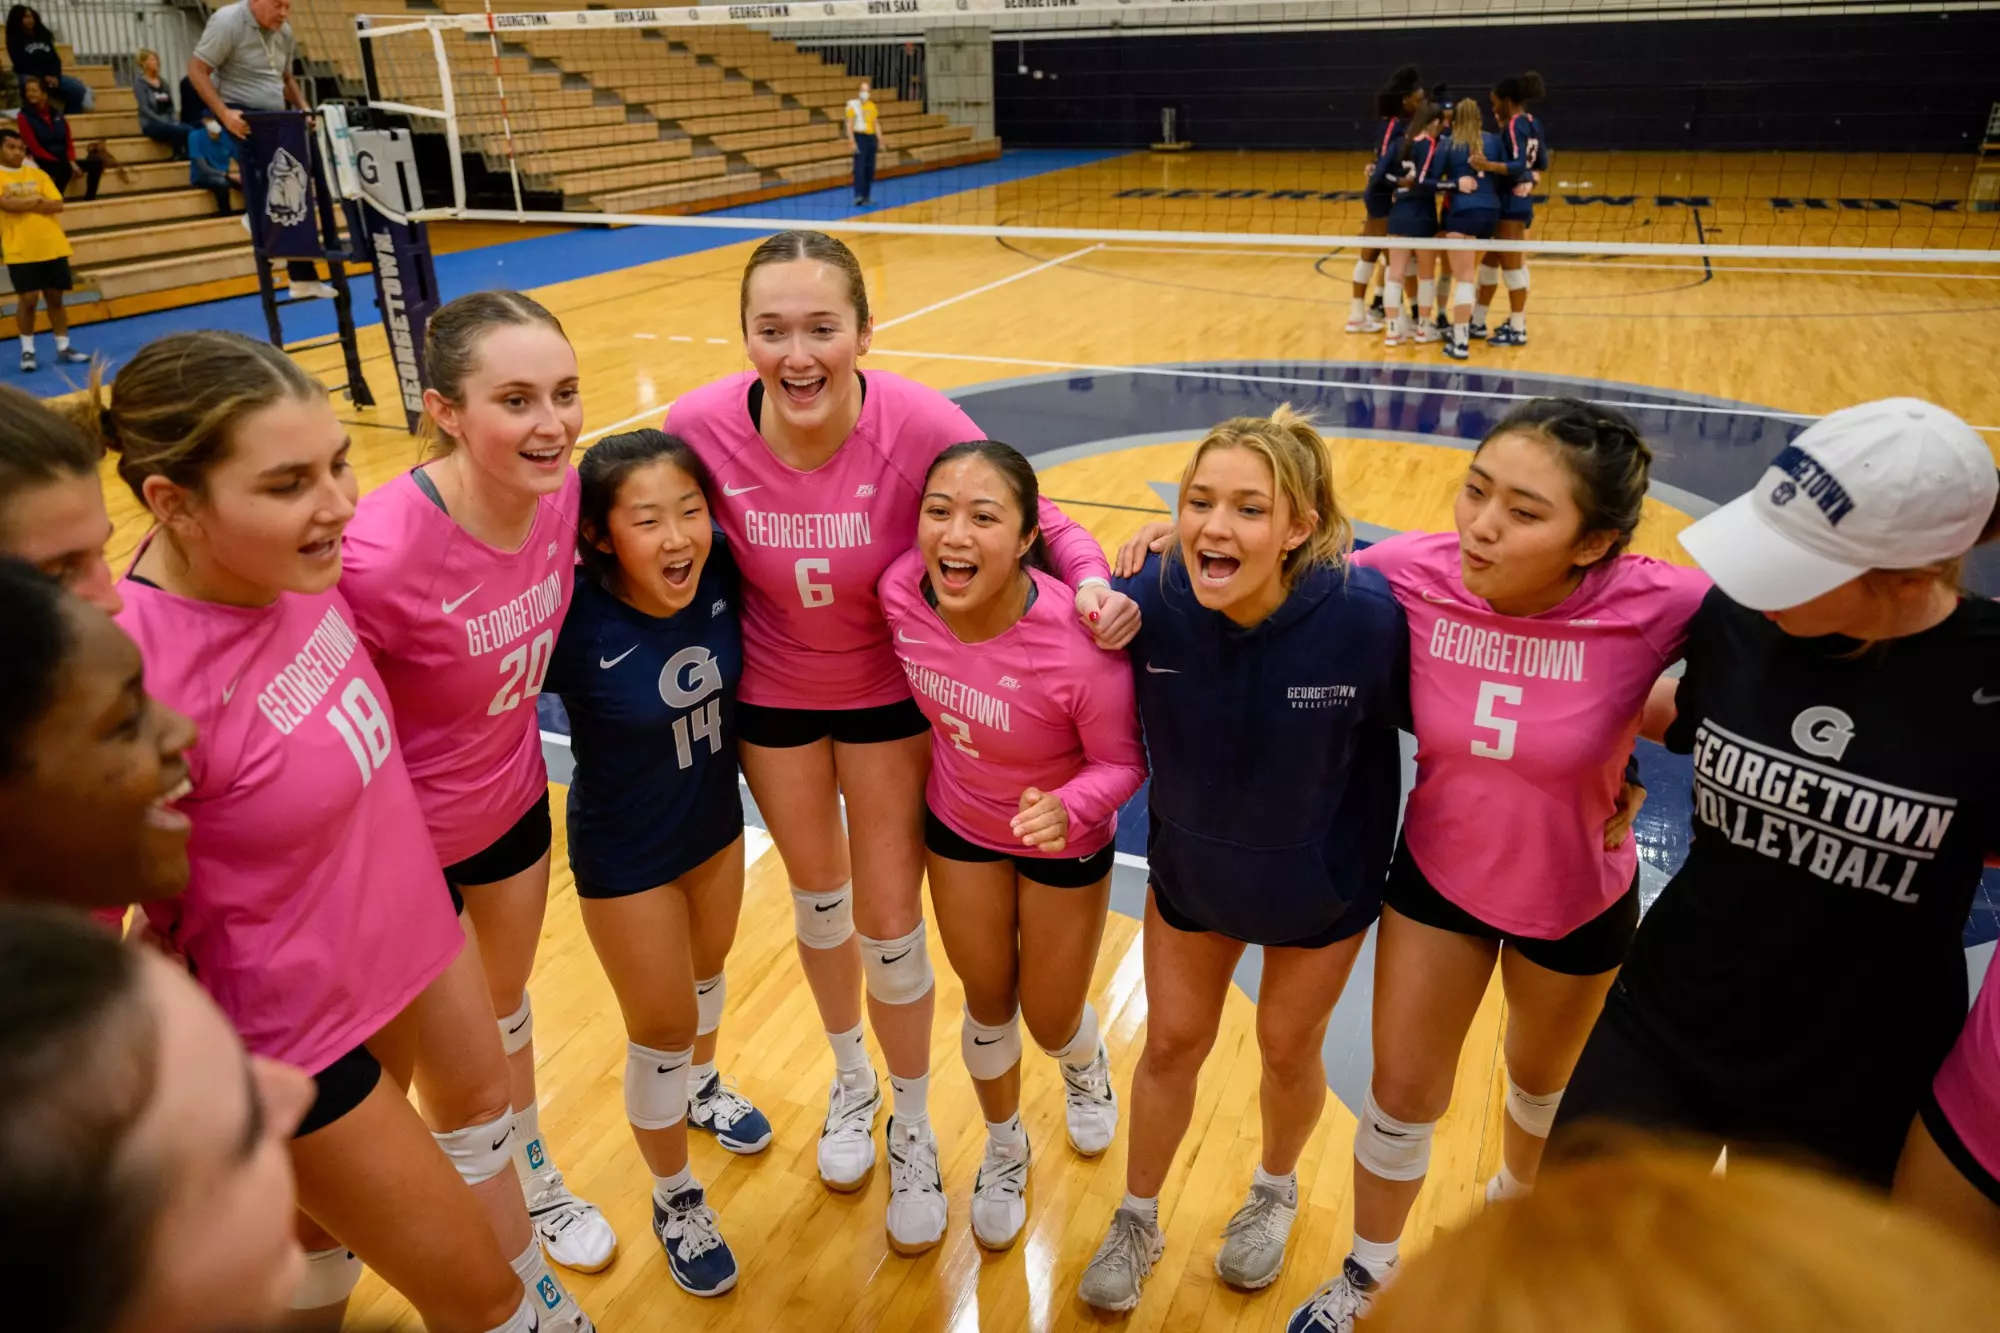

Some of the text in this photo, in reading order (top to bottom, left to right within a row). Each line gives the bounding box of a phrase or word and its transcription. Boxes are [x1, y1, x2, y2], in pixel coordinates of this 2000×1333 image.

[729, 5, 790, 19] GEORGETOWN
[894, 0, 920, 12] SAXA
[357, 150, 379, 184] G
[372, 231, 425, 413] GEORGETOWN
[745, 510, 872, 549] GEORGETOWN
[465, 570, 562, 657] GEORGETOWN
[794, 558, 835, 608] 6
[257, 605, 358, 735] GEORGETOWN
[487, 628, 553, 716] 20
[658, 646, 723, 708] G
[1429, 618, 1585, 682] GEORGETOWN
[904, 657, 1010, 733] GEORGETOWN
[1287, 685, 1356, 699] GEORGETOWN
[1470, 680, 1523, 760] 5
[326, 677, 392, 788] 18
[672, 697, 722, 770] 14
[940, 712, 979, 758] 2
[1791, 706, 1856, 762] G
[1695, 782, 1920, 903] OLLEYBALL
